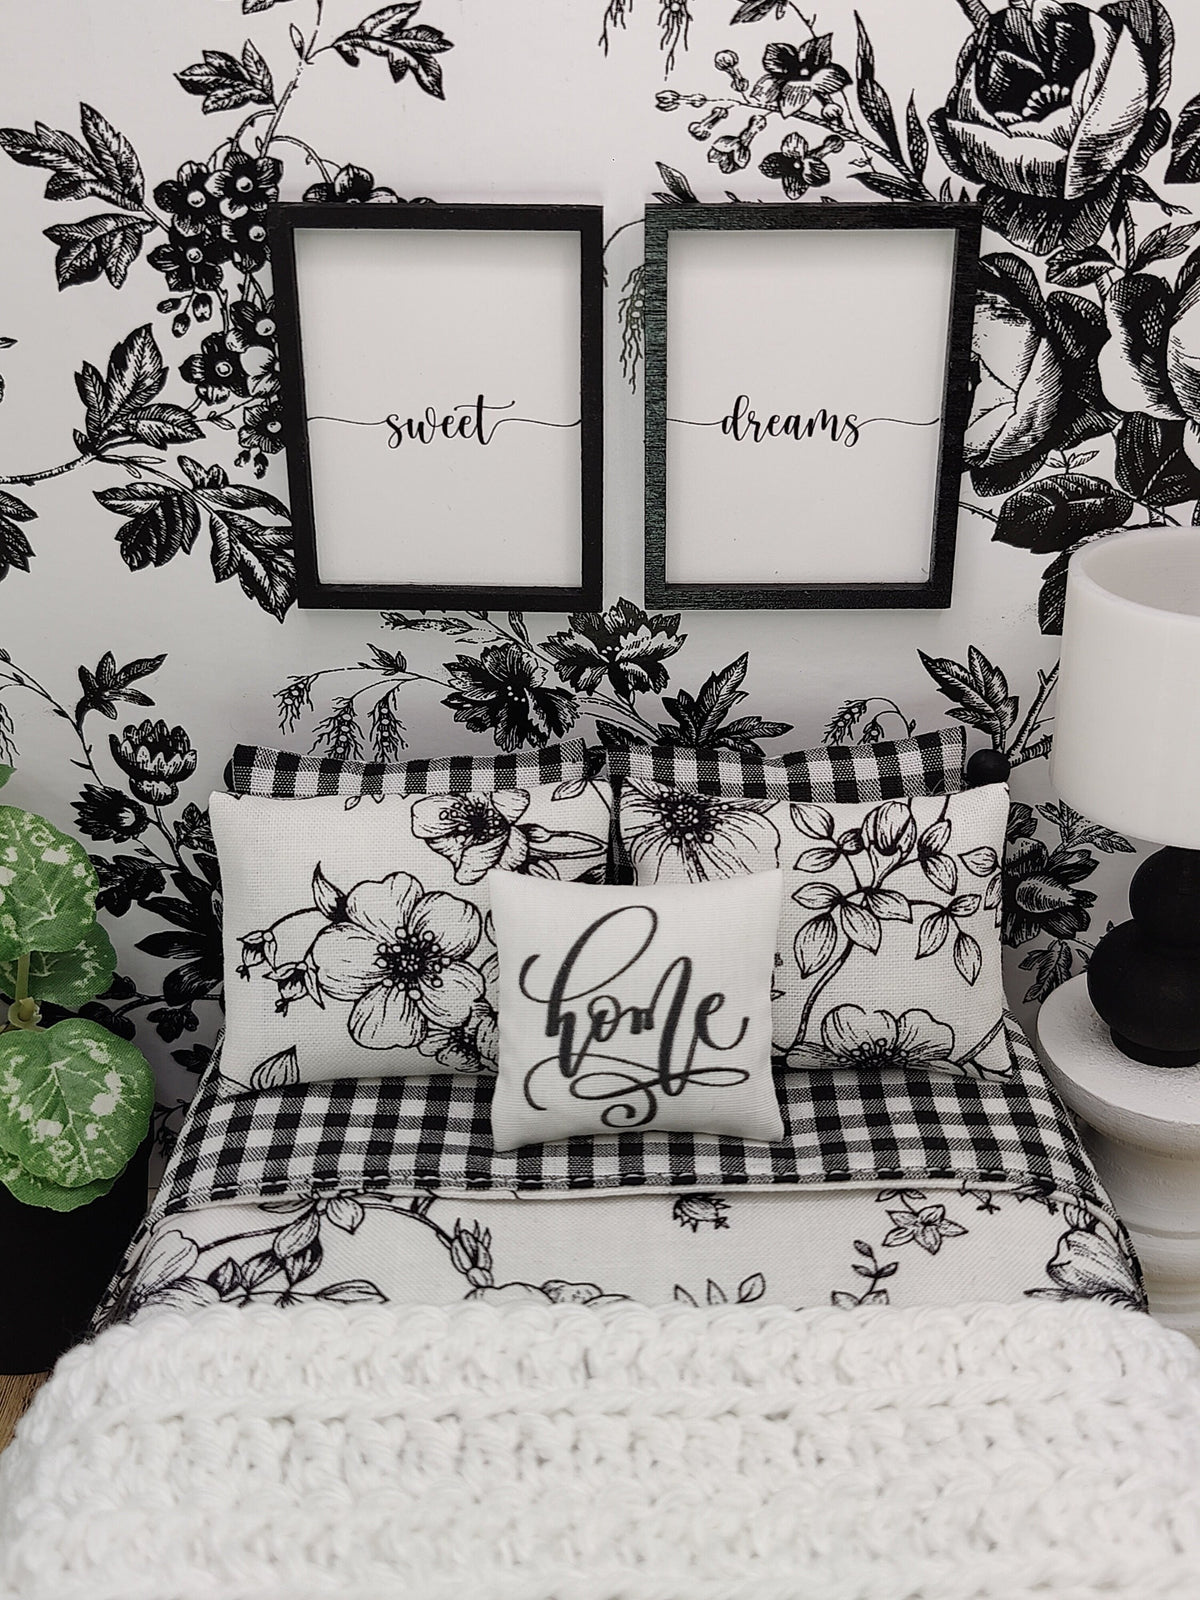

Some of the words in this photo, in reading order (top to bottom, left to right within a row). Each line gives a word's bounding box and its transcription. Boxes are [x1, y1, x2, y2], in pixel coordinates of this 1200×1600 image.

[385, 394, 515, 449] sweet
[721, 394, 860, 448] dreams
[519, 905, 750, 1097] home
